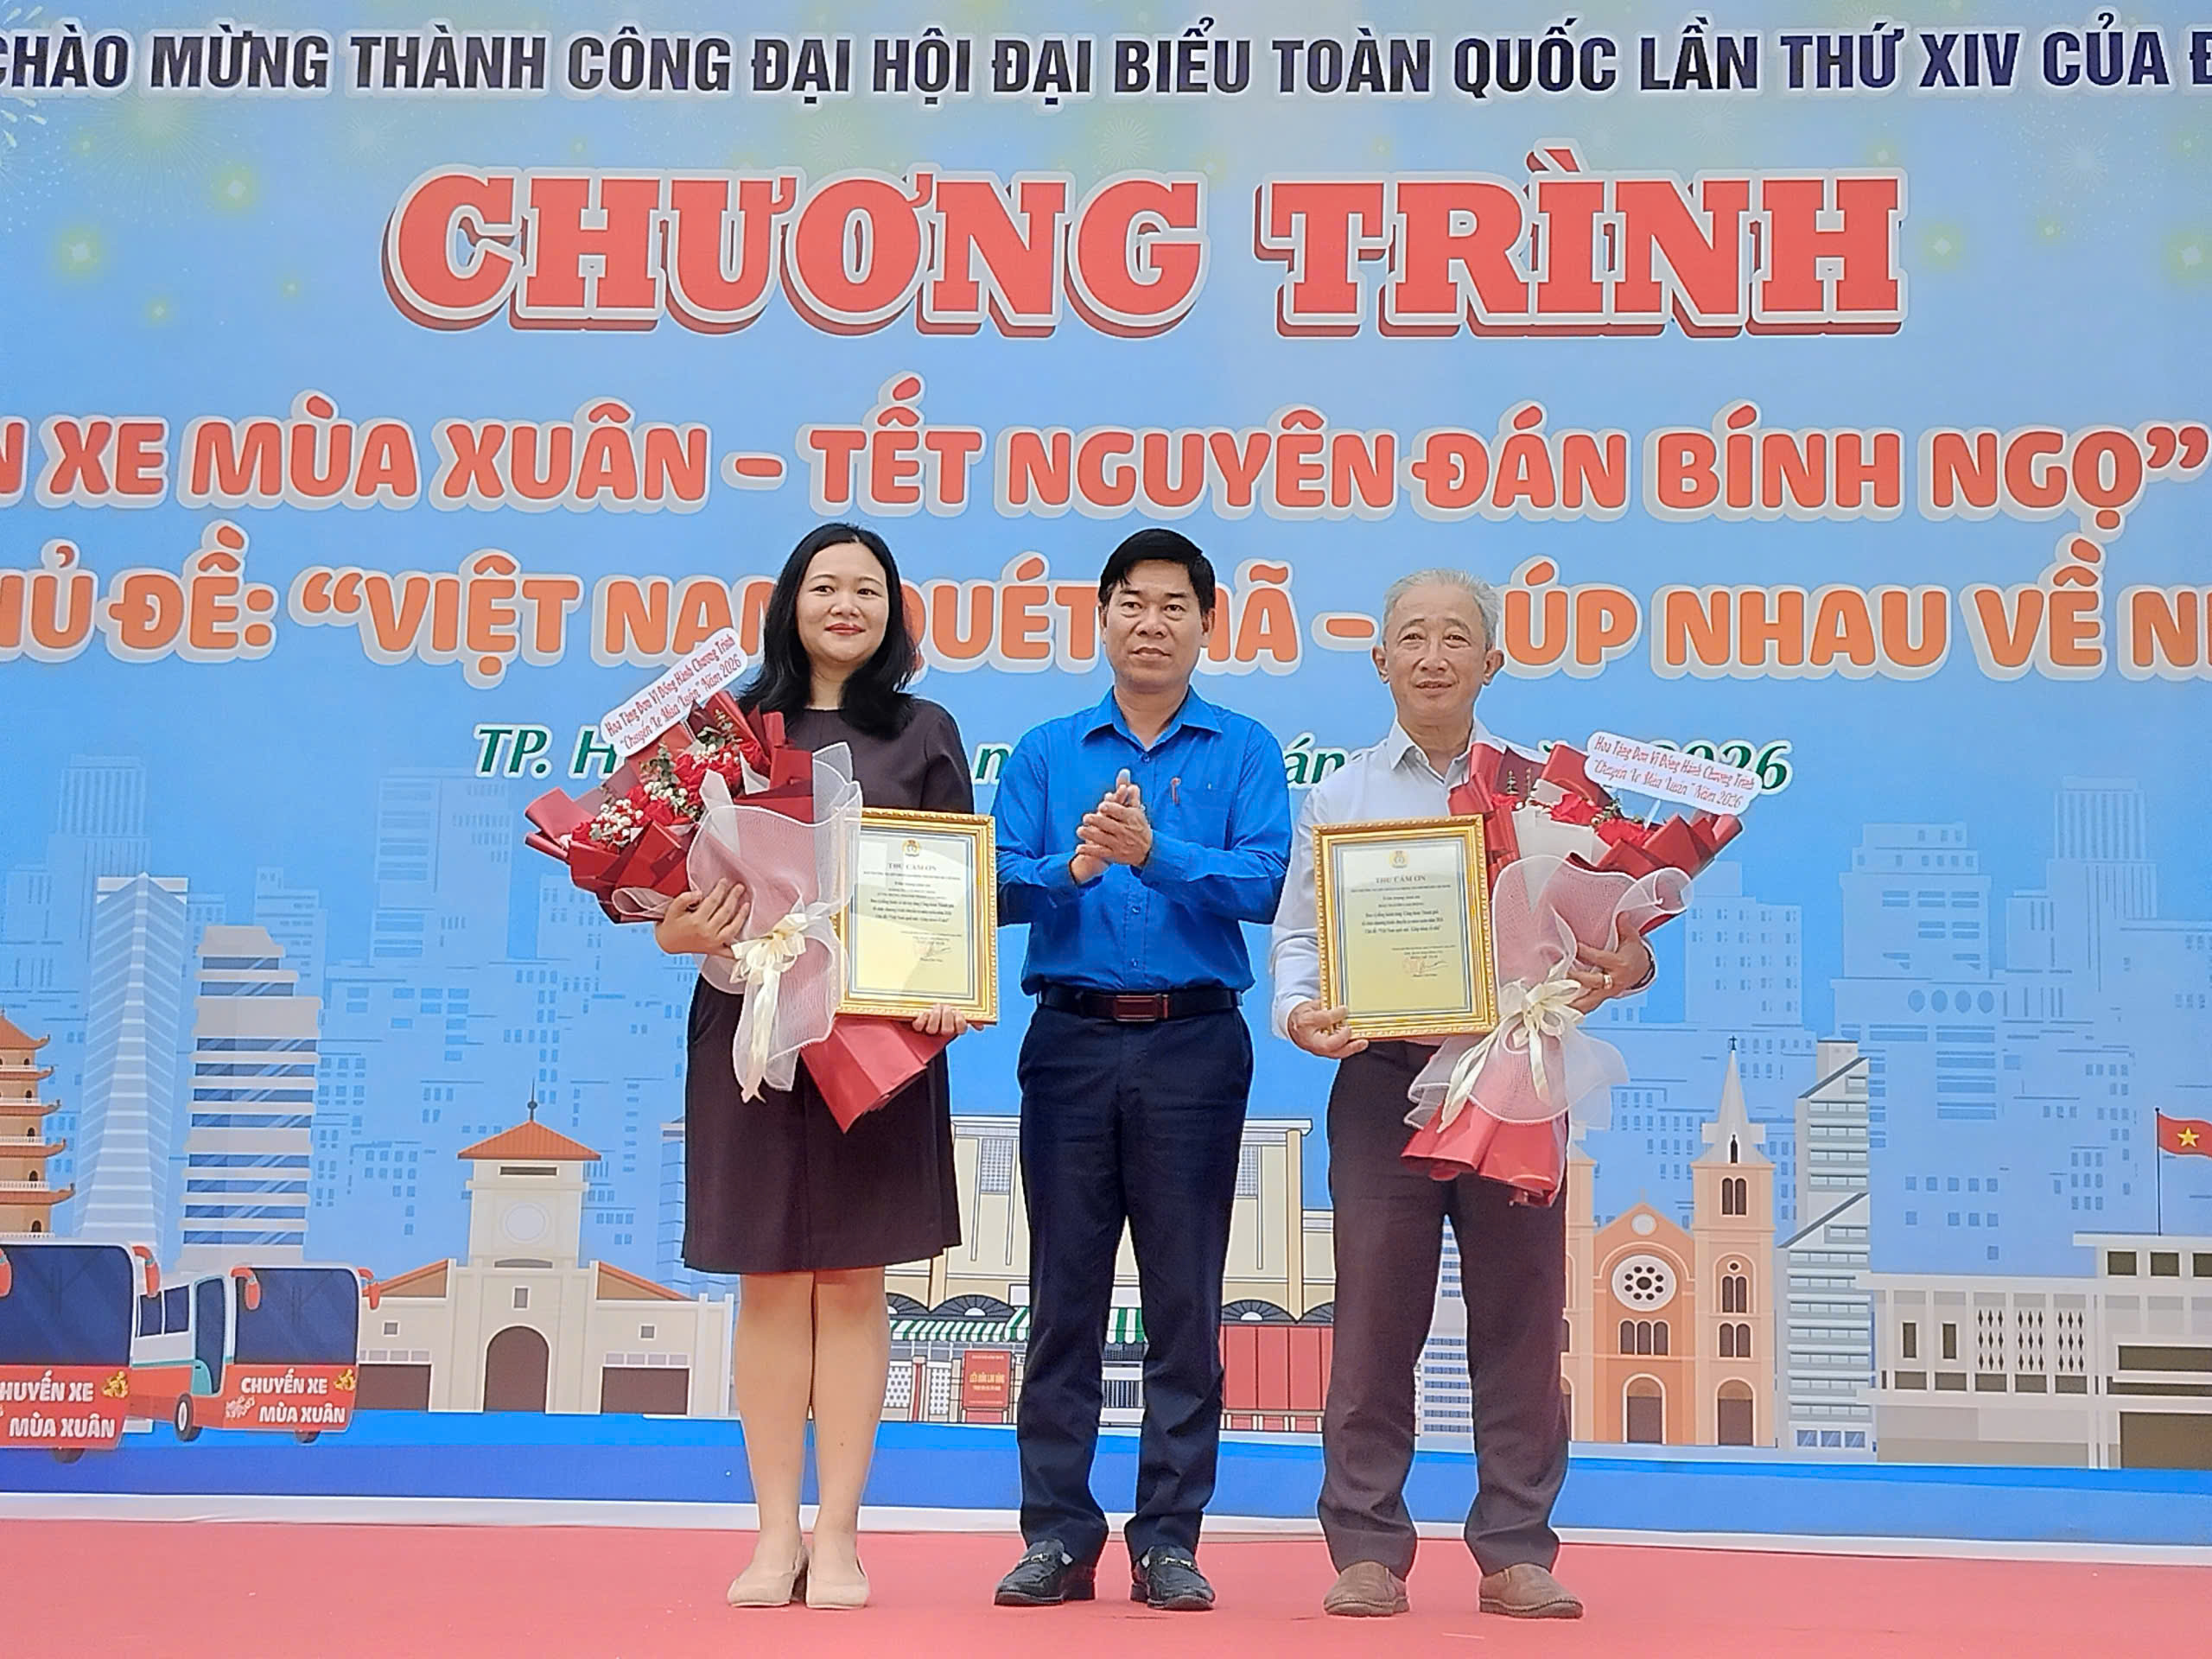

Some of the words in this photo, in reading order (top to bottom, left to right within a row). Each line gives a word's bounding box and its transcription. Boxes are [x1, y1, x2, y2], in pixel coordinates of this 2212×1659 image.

[0, 24, 129, 88] HÀO
[151, 23, 329, 89] MỪNG
[351, 23, 545, 90] THÀNH
[568, 26, 730, 92] CÔNG
[751, 39, 849, 105] ĐẠI
[872, 27, 970, 105] HỘI
[991, 39, 1092, 105] ĐẠI
[1114, 16, 1251, 93] BIỂU
[1272, 27, 1431, 93] TOÀN
[1453, 17, 1618, 99] QUỐC
[1640, 16, 1759, 91] LẦN
[1780, 22, 1905, 90] THỨ
[1918, 32, 2021, 87] XIV
[2042, 11, 2171, 87] CỦA
[393, 168, 1208, 333] CHƯƠNG
[1263, 145, 1904, 325] TRÌNH
[49, 420, 165, 496] XE
[189, 394, 418, 499] MÙA
[442, 401, 709, 502] XUÂN
[809, 375, 982, 505] TẾT
[1007, 408, 1395, 508] NGUYÊN
[1411, 404, 1627, 510] ĐÁN
[1656, 404, 1902, 510] BÍNH
[108, 524, 275, 652] ĐỀ:
[302, 553, 580, 677] “VIỆT
[1504, 561, 1638, 665] ÚP
[1666, 588, 1948, 666] NHAU
[1973, 537, 2102, 668] VỀ
[2132, 590, 2212, 668] N
[720, 654, 741, 677] 2026
[479, 728, 548, 774] TP.
[573, 730, 617, 774] H
[0, 1370, 65, 1402] HUYẾN
[68, 1382, 94, 1402] XE
[241, 1368, 305, 1395] CHUYẾN
[307, 1377, 328, 1395] XE
[10, 1412, 57, 1438] MÙA
[60, 1413, 116, 1439] XUÂN
[259, 1402, 298, 1423] MÙA
[300, 1402, 346, 1424] XUÂN
